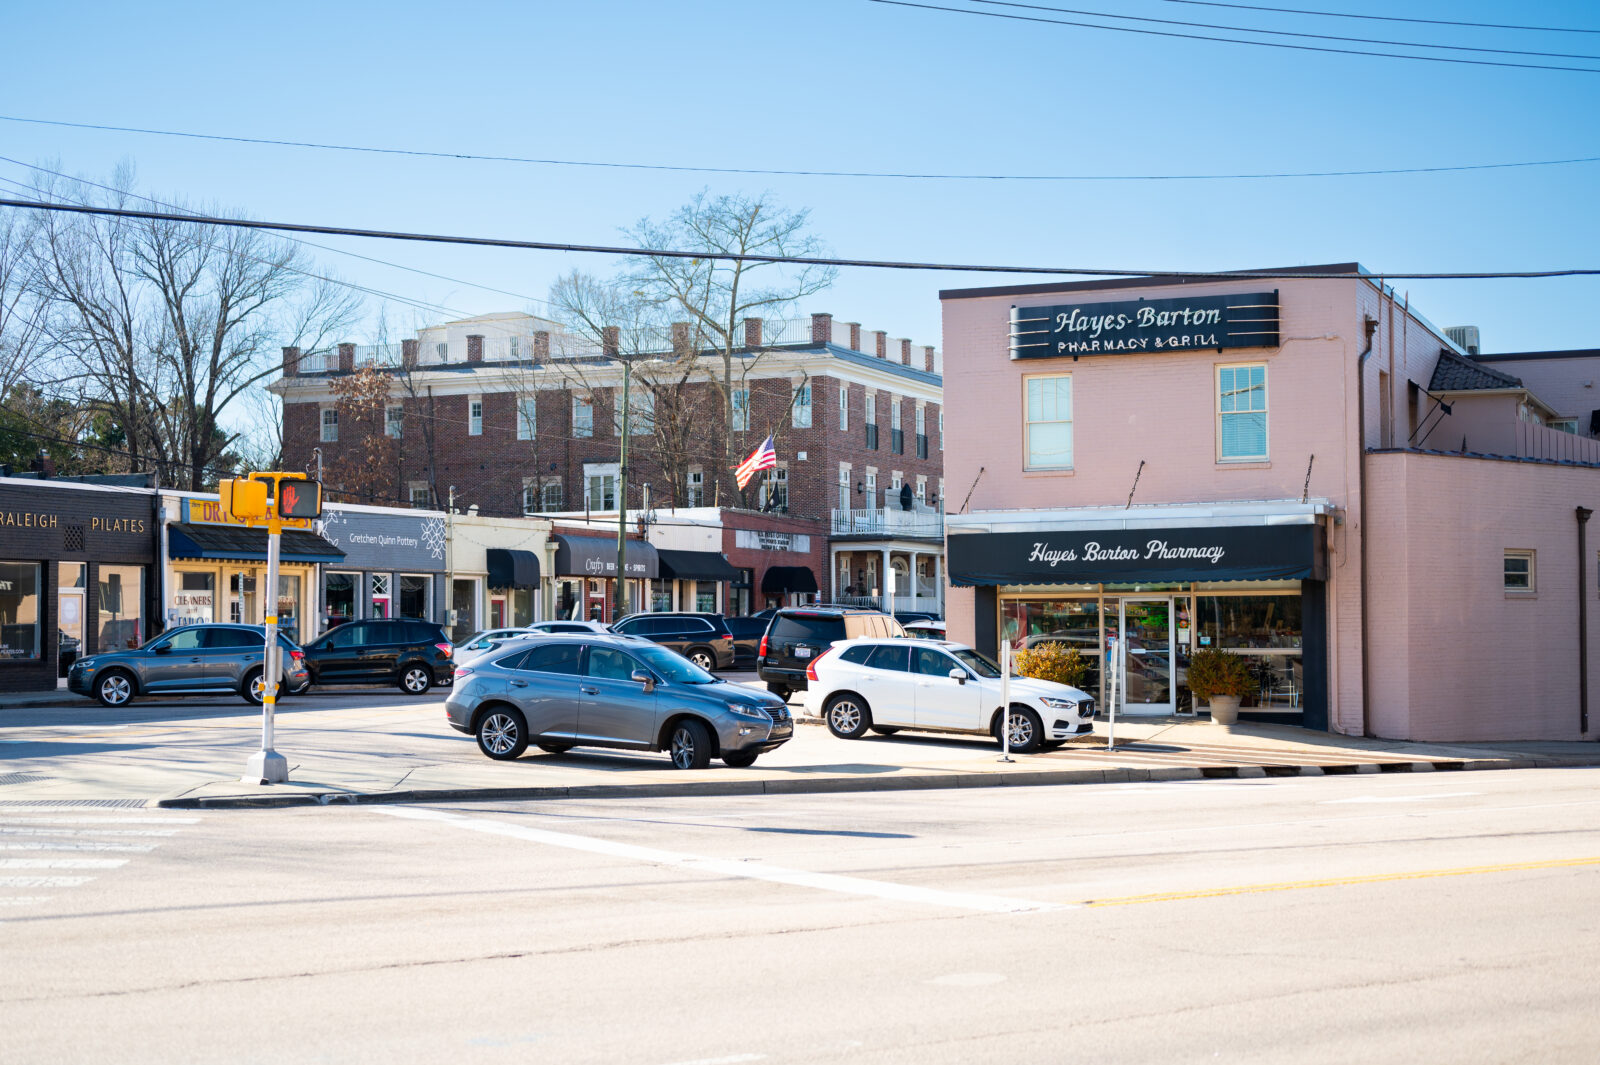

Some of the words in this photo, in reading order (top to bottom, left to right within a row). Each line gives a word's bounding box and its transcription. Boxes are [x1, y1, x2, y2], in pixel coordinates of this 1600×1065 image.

[1057, 338, 1149, 353] PHARMACY
[0, 511, 57, 528] RALEIGH
[92, 517, 145, 533] PILATES
[349, 533, 378, 544] Gretchen
[378, 535, 396, 547] Quinn
[397, 536, 418, 548] Pottery
[1028, 542, 1078, 567] Hayes
[1082, 541, 1140, 562] Barton
[1144, 540, 1225, 564] Pharmacy
[586, 557, 603, 574] Crafty
